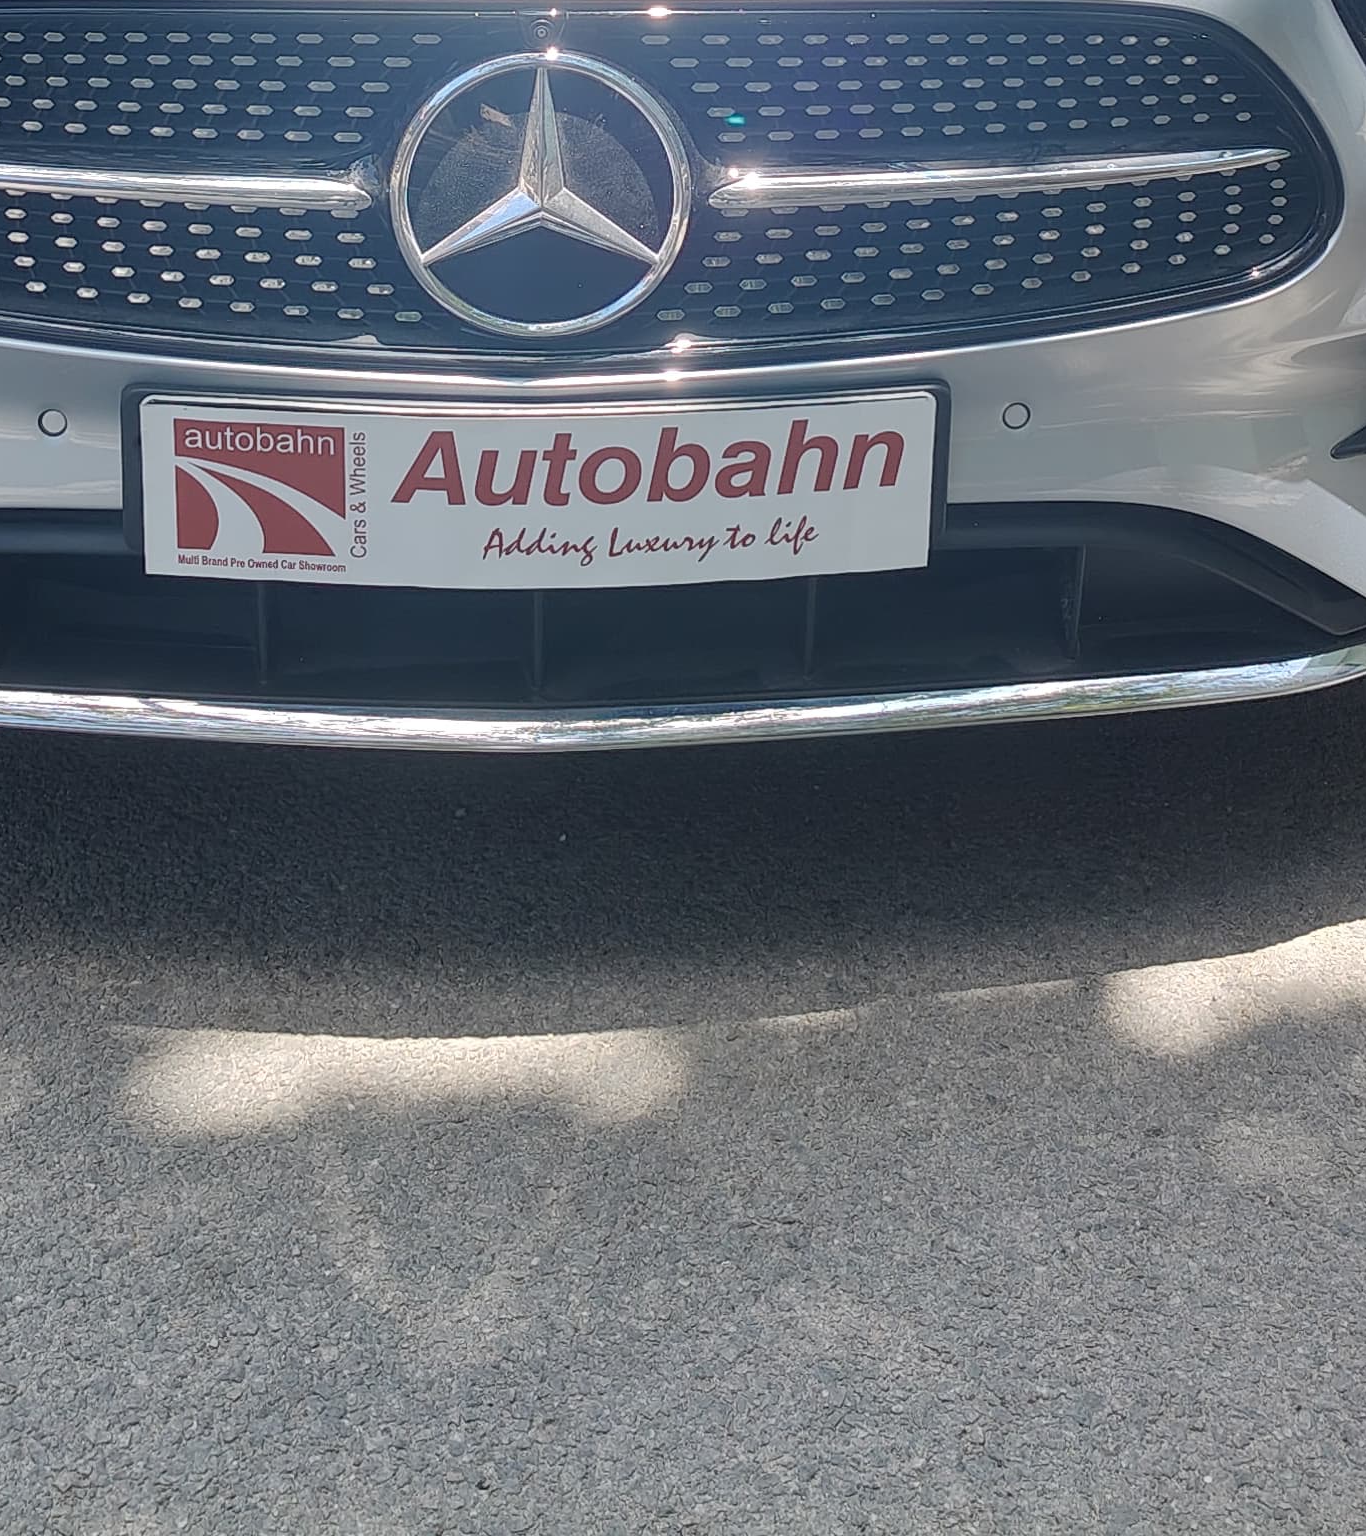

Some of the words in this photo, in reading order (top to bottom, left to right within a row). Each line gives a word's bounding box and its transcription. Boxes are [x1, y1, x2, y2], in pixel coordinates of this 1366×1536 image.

[185, 426, 336, 456] autobahn
[348, 431, 367, 496] Wheels
[390, 418, 905, 507] Autobahn
[349, 500, 367, 514] &
[349, 518, 367, 559] Cars
[482, 526, 598, 567] Adding
[607, 526, 718, 563] Luxury
[721, 523, 757, 550] to
[763, 515, 820, 556] life
[178, 554, 200, 566] Multi
[201, 555, 229, 568] Brand
[247, 558, 279, 570] Owned
[280, 559, 297, 570] Car
[298, 560, 347, 573] Showroom
